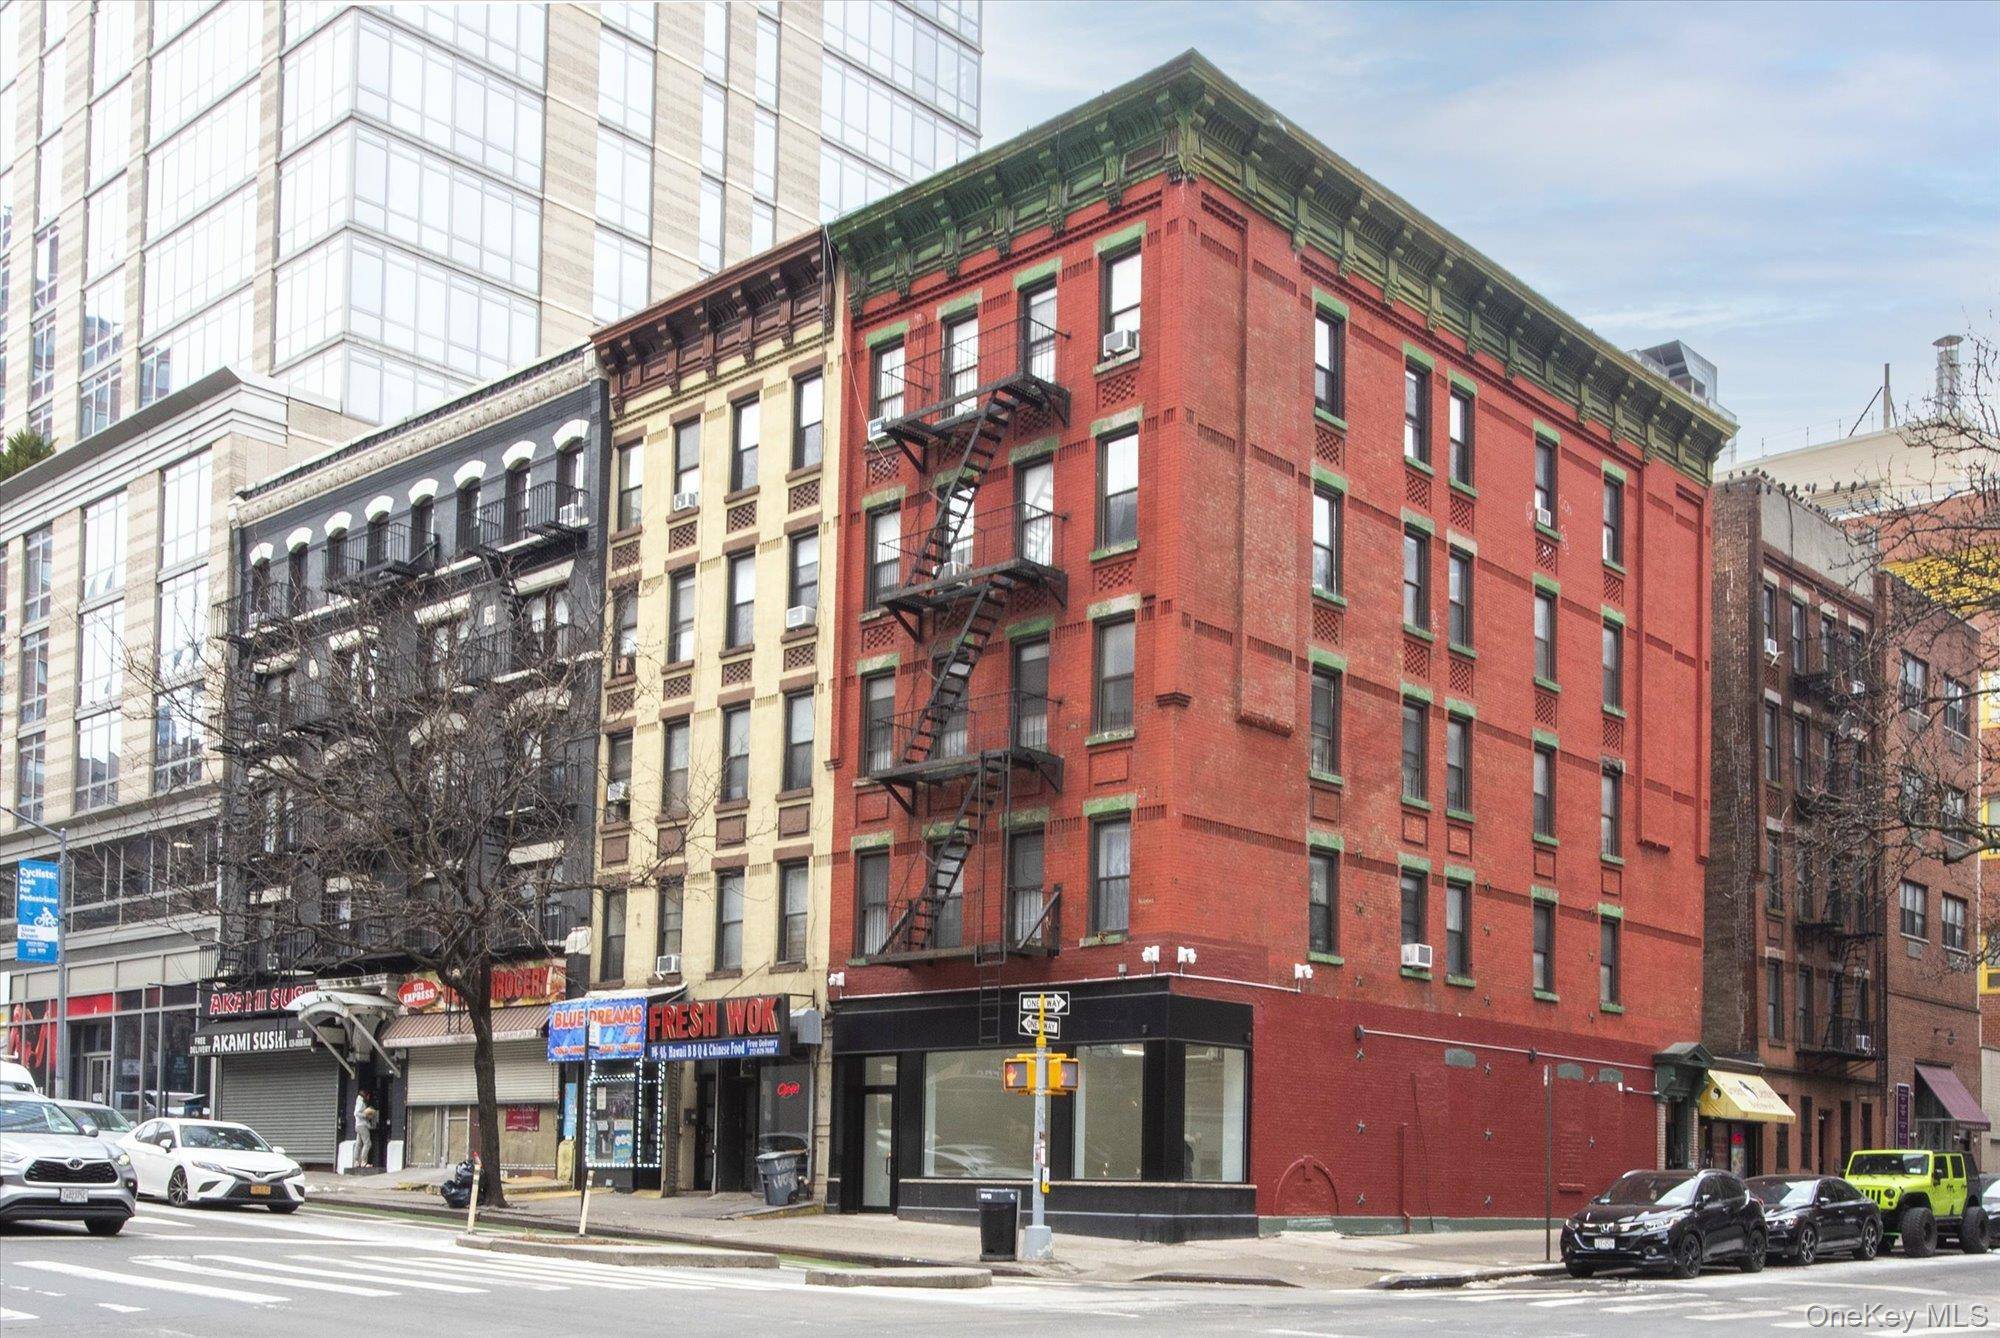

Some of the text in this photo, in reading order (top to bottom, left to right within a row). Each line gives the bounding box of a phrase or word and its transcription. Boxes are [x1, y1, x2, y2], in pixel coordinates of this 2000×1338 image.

[20, 867, 57, 879] Cyclists:
[20, 893, 58, 904] Pedestrians
[491, 966, 548, 1003] ROCERY
[209, 989, 267, 1015] AKAMI
[403, 988, 435, 1003] EXPRESS
[1026, 999, 1061, 1009] ONE WAY
[553, 1003, 643, 1031] BLUE DREAMS
[648, 997, 779, 1040] FRESH WOK
[1026, 1019, 1056, 1031] ONE WAY
[195, 1036, 206, 1045] FREE
[212, 1033, 250, 1053] AKAMI
[253, 1030, 287, 1051] SUSHI
[747, 1040, 759, 1049] Free
[189, 1045, 211, 1055] DELIVERY
[668, 1045, 687, 1058] Hawaii
[709, 1043, 730, 1056] Chinese
[731, 1041, 745, 1055] Food
